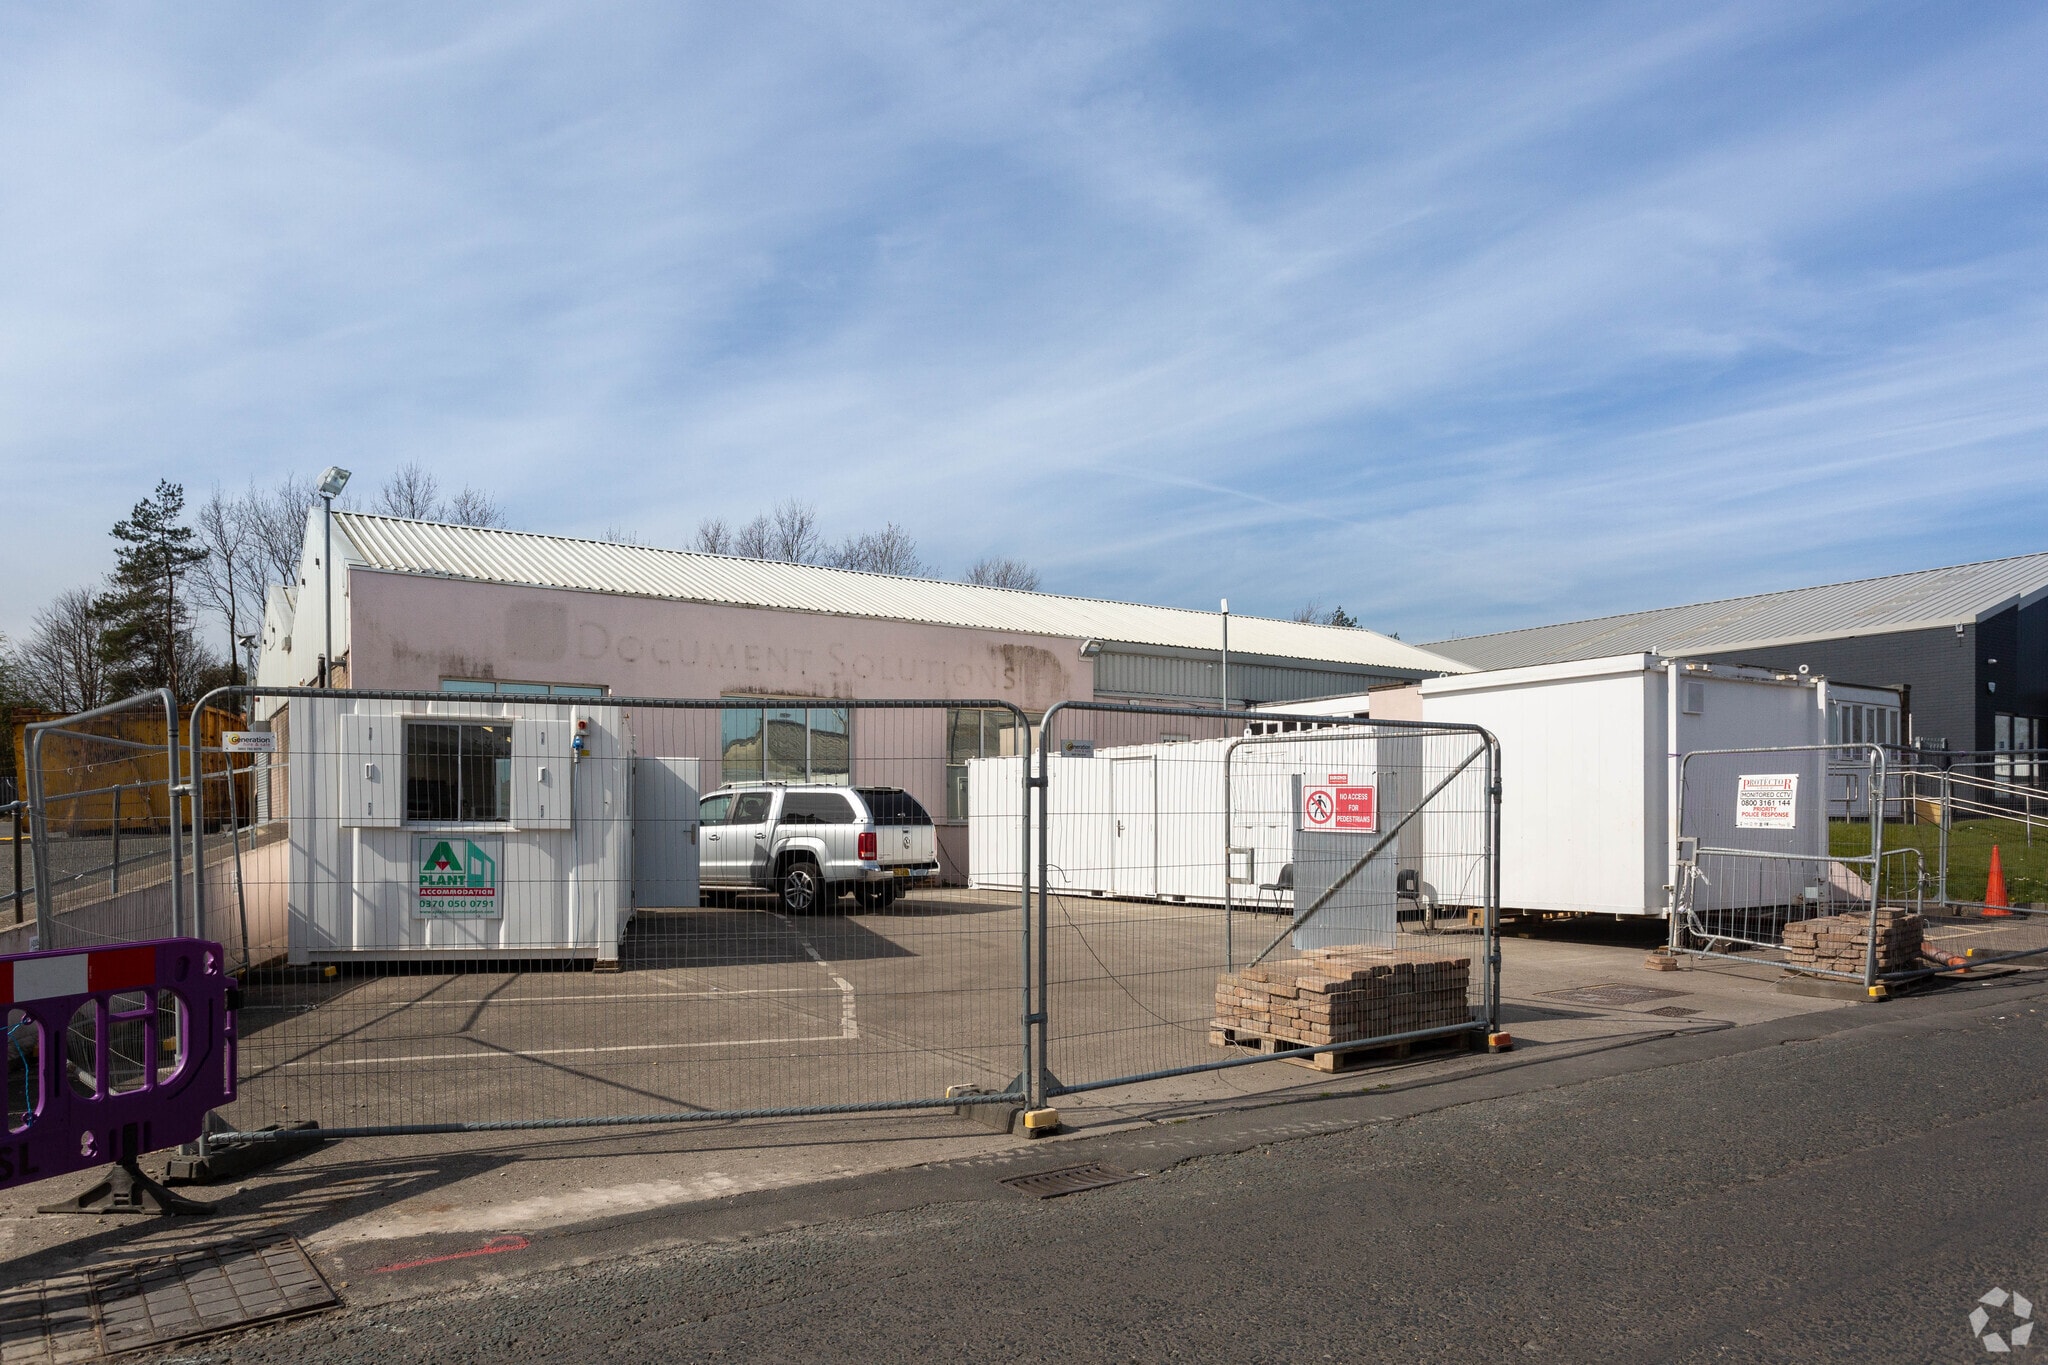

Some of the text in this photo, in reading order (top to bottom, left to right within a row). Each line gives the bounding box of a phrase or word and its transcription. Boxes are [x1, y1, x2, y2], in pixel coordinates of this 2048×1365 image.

[231, 735, 271, 743] Generation
[1743, 779, 1792, 789] PROTECTOR
[1337, 815, 1370, 823] PEDESTRIANS
[423, 841, 463, 871] A
[419, 875, 465, 885] PLANT
[419, 900, 494, 908] 0370 050 0791
